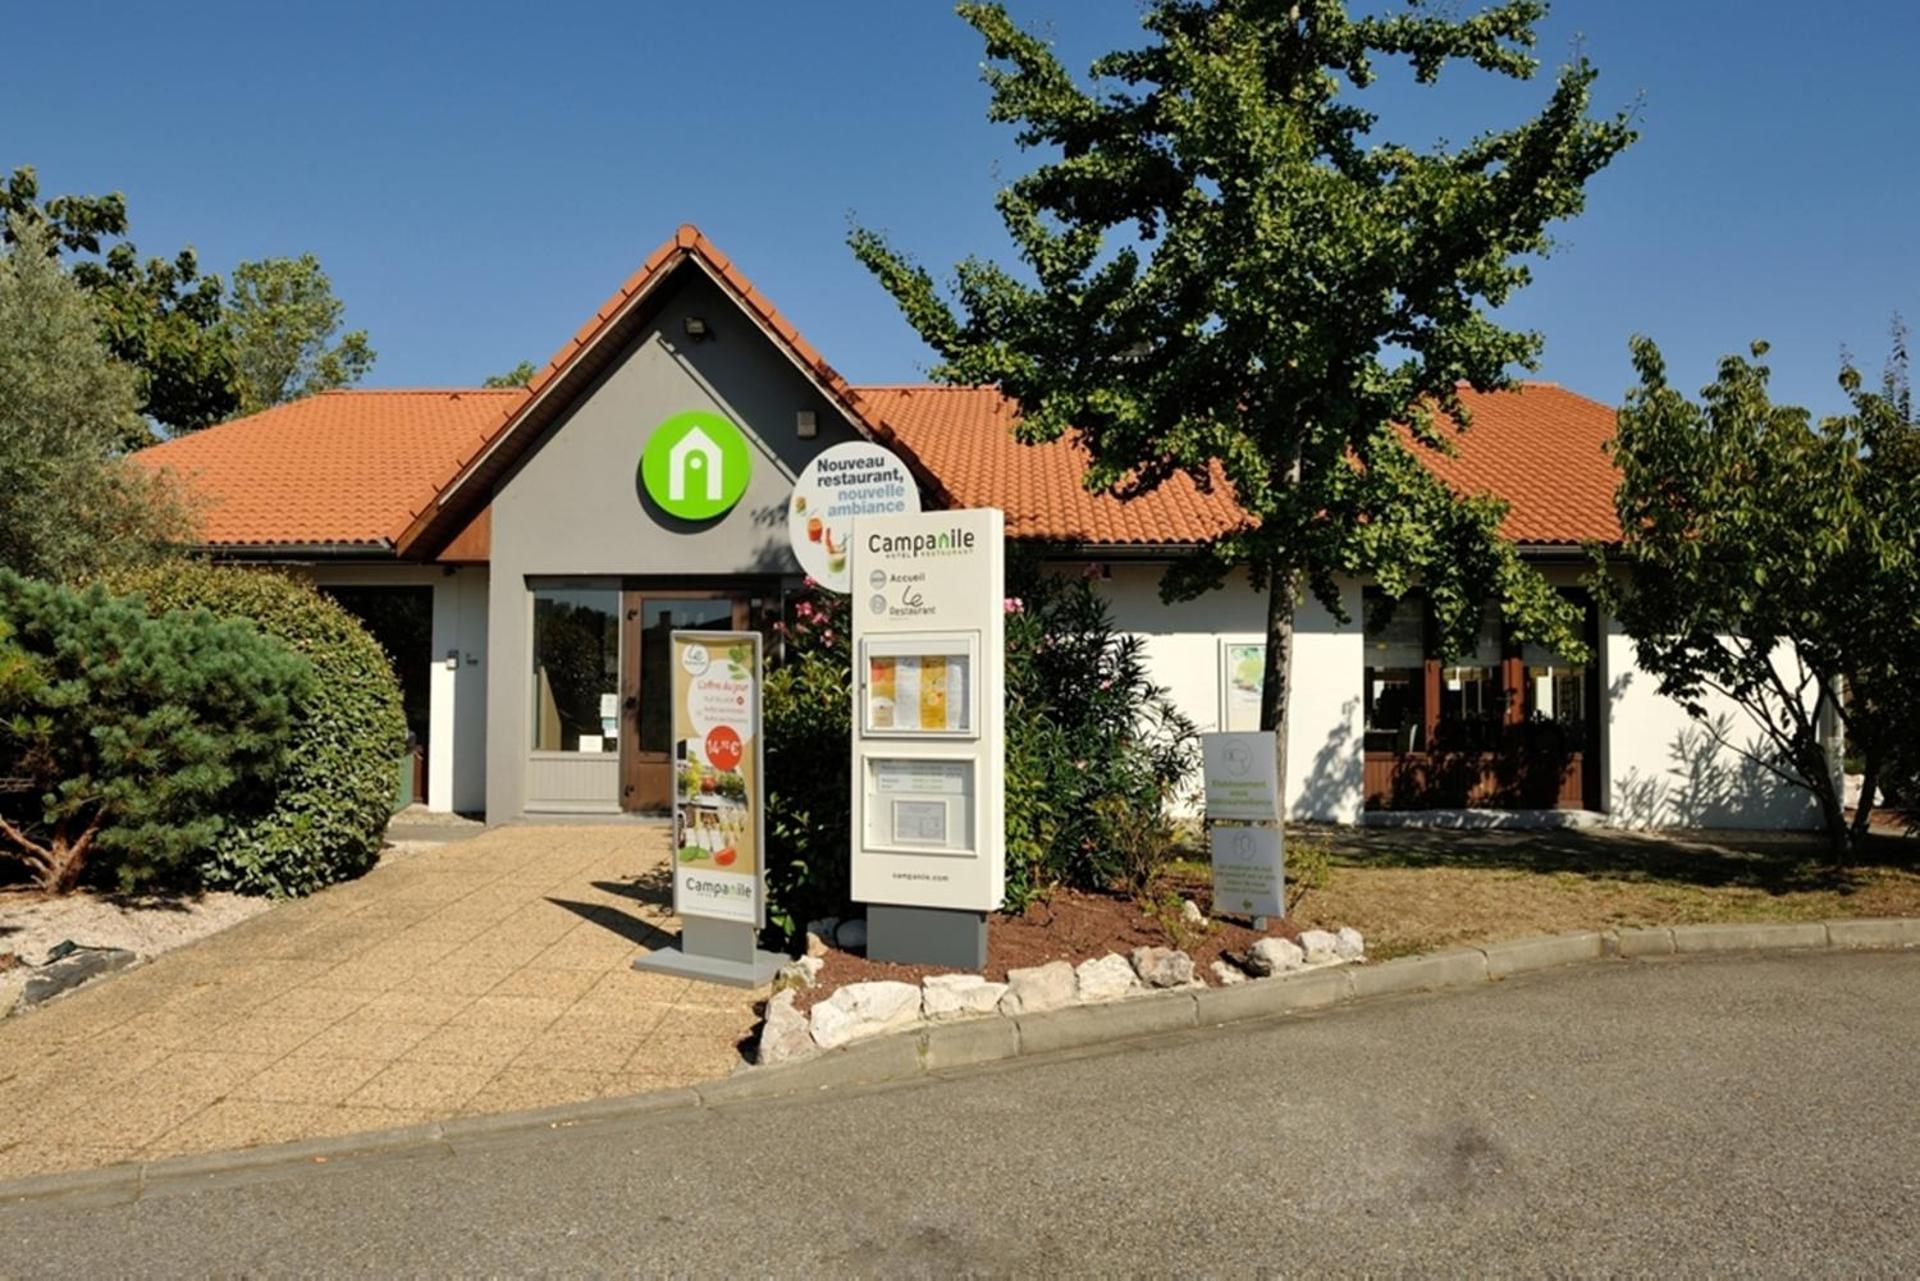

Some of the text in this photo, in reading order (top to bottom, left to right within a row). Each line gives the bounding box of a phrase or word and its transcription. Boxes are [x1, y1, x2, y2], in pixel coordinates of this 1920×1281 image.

[817, 456, 885, 472] Nouveau
[817, 468, 904, 487] restaurant,
[838, 484, 905, 500] nouvelle
[828, 501, 905, 517] ambiance
[868, 528, 975, 557] Campanile
[889, 573, 926, 583] Accueil
[902, 585, 924, 608] Le
[889, 606, 936, 616] Restaurant
[686, 876, 752, 898] Campanile
